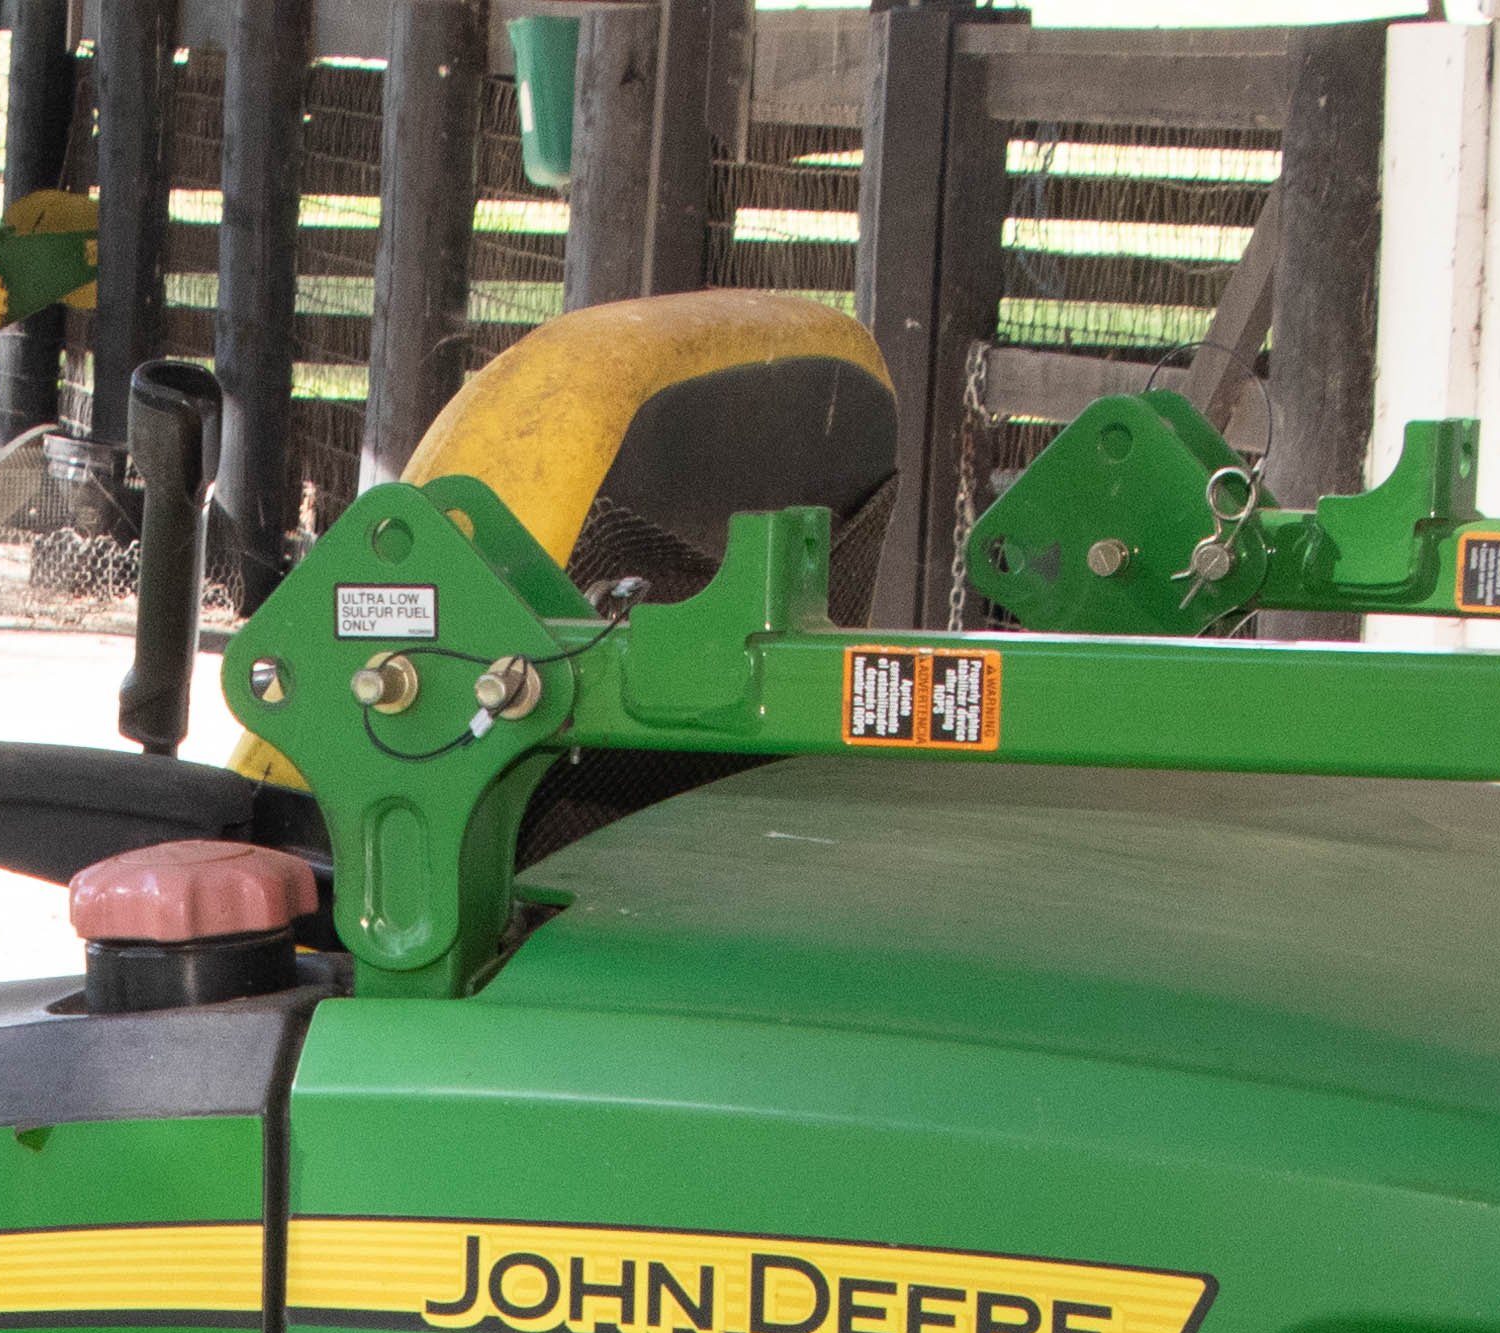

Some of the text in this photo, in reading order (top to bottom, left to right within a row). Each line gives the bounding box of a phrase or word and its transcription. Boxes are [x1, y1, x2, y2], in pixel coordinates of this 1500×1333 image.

[342, 593, 419, 605] ULTRA LOW
[342, 606, 431, 619] SULFUR FUEL
[342, 619, 376, 631] ONLY
[852, 706, 865, 736] ROPS
[888, 660, 900, 734] correctamente
[915, 664, 929, 745] ADVERTENCIA
[933, 684, 946, 715] ROPS
[942, 669, 957, 731] after raising
[956, 658, 969, 742] stabilizer device
[967, 660, 982, 742] Properly tighten
[984, 679, 997, 738] WARNING
[425, 1235, 717, 1333] JOHN
